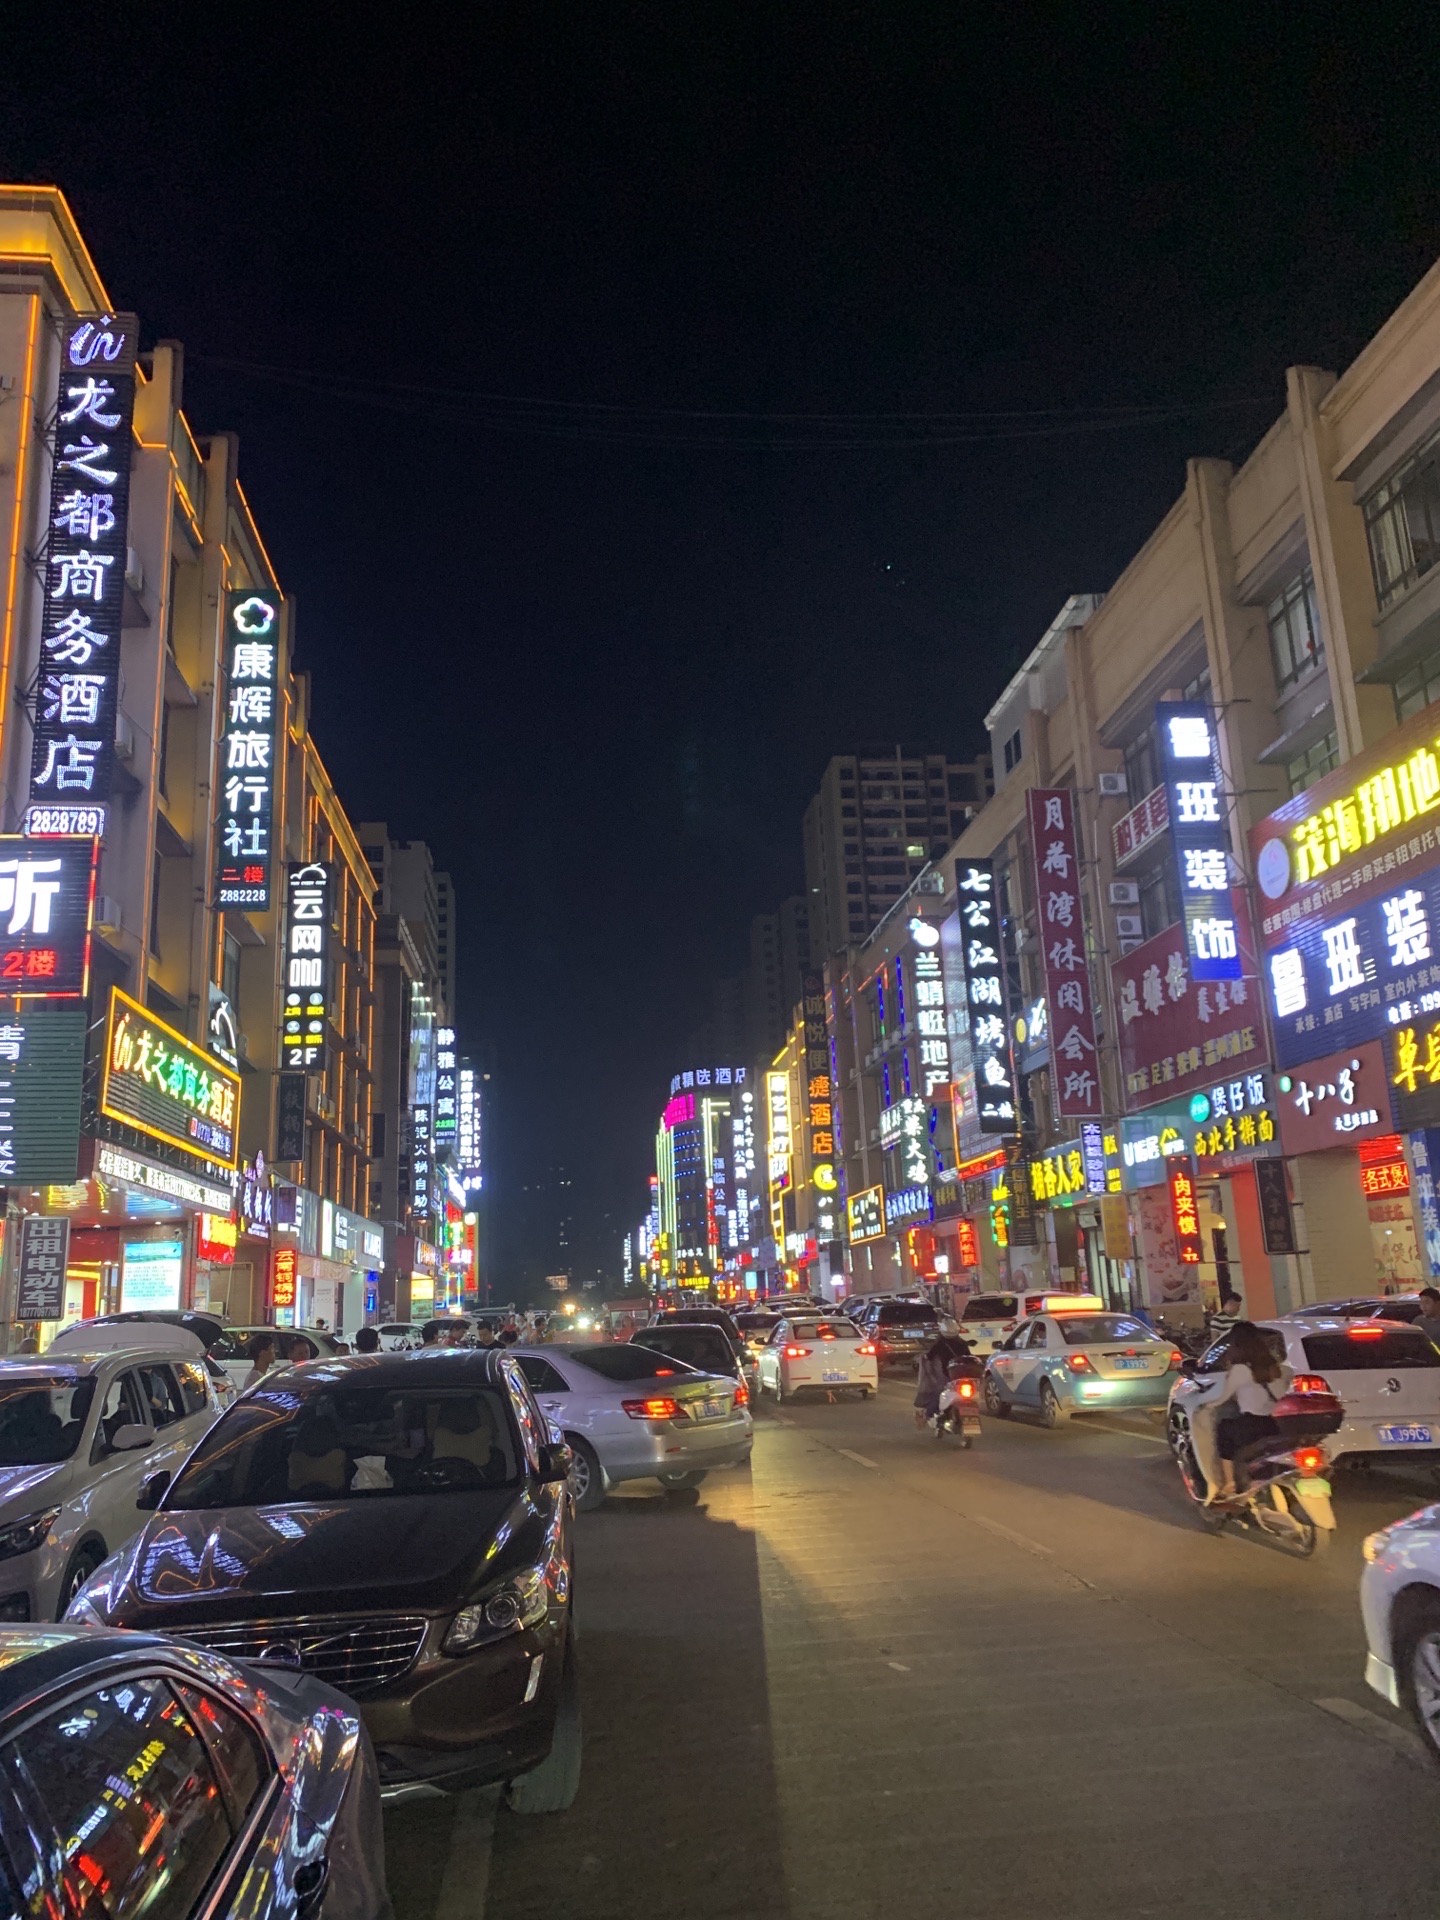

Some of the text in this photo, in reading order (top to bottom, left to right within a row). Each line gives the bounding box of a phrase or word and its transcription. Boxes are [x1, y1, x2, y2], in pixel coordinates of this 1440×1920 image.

[33, 377, 123, 791] 龙之都商务酒店
[222, 642, 274, 857] 康辉旅行社
[31, 810, 98, 833] 2828789
[1168, 717, 1238, 960] 鲁班装饰
[1292, 737, 1440, 884] 茂海翔地
[220, 889, 266, 902] 2882228
[221, 866, 265, 884] 二楼
[3, 949, 58, 978] 2楼
[289, 889, 324, 988] 云网咖
[959, 868, 1011, 1088] 七公江湖烤鱼
[290, 1047, 318, 1066] 2F
[915, 951, 949, 1097] 兰蜻蜓地产
[437, 1028, 456, 1116] 静雅公寓
[805, 995, 833, 1155] 诚悦便捷酒店
[1211, 1074, 1266, 1118] 煲仔饭
[713, 1158, 727, 1217] 福临公寓
[1174, 1178, 1198, 1235] 肉夹馍
[22, 1221, 62, 1307] 出租电动车
